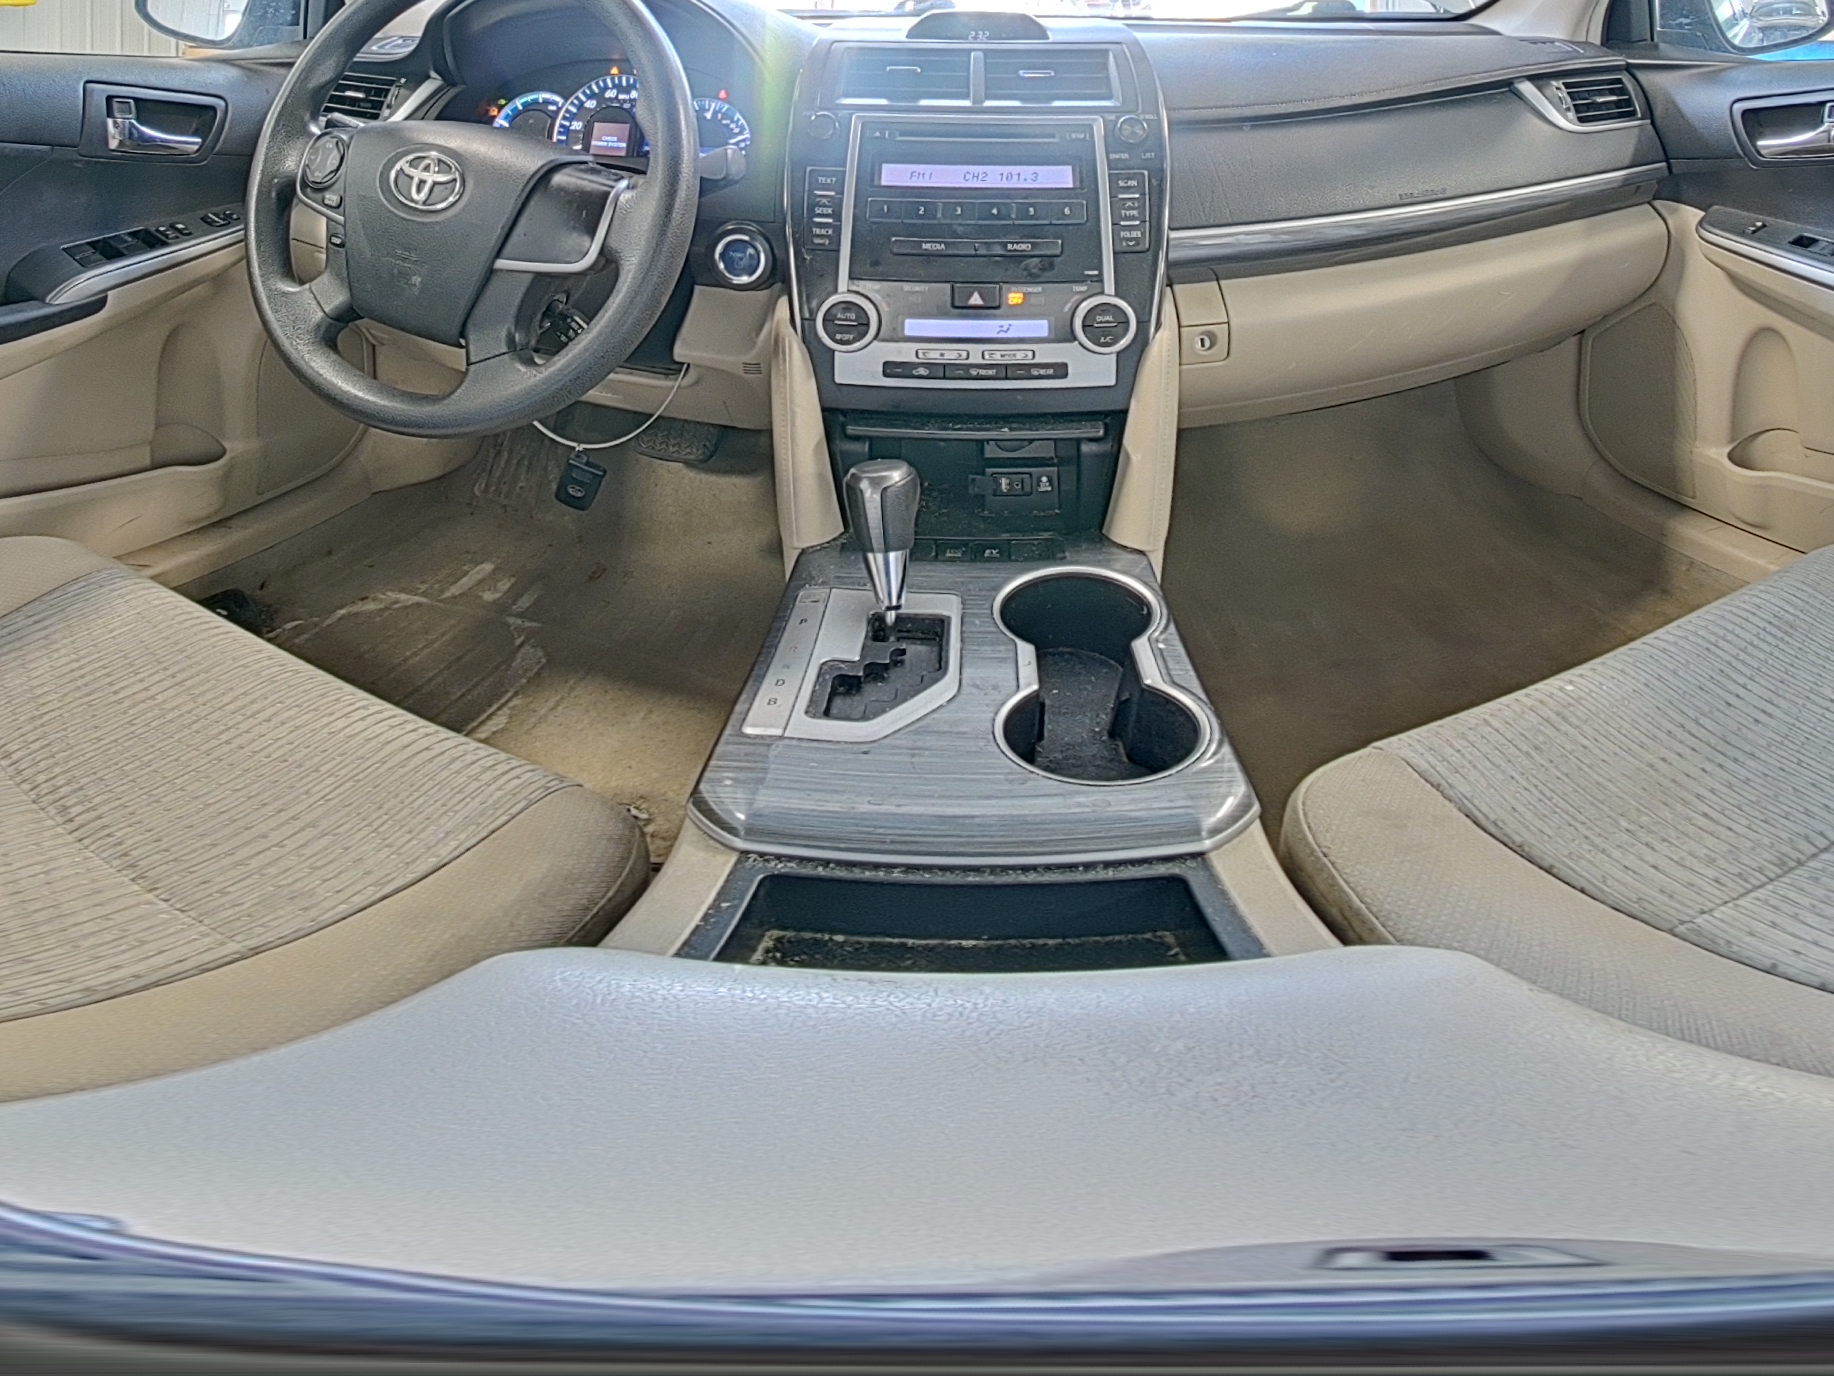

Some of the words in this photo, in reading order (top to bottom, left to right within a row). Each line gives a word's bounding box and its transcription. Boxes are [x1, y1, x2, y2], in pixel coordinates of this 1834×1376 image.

[604, 88, 618, 99] 60
[583, 99, 597, 109] 40
[569, 121, 583, 131] 20
[1141, 152, 1156, 160] LIST
[962, 171, 989, 182] CH2
[998, 171, 1040, 183] 101.3
[1117, 179, 1138, 187] SCAN
[814, 207, 834, 215] SEEK
[1120, 210, 1139, 218] TYPE
[921, 243, 946, 251] MEDIA
[1007, 243, 1032, 251] RADIO
[1008, 297, 1024, 305] OFF
[836, 312, 856, 320] AUTO
[774, 678, 786, 687] D
[767, 697, 778, 706] B
